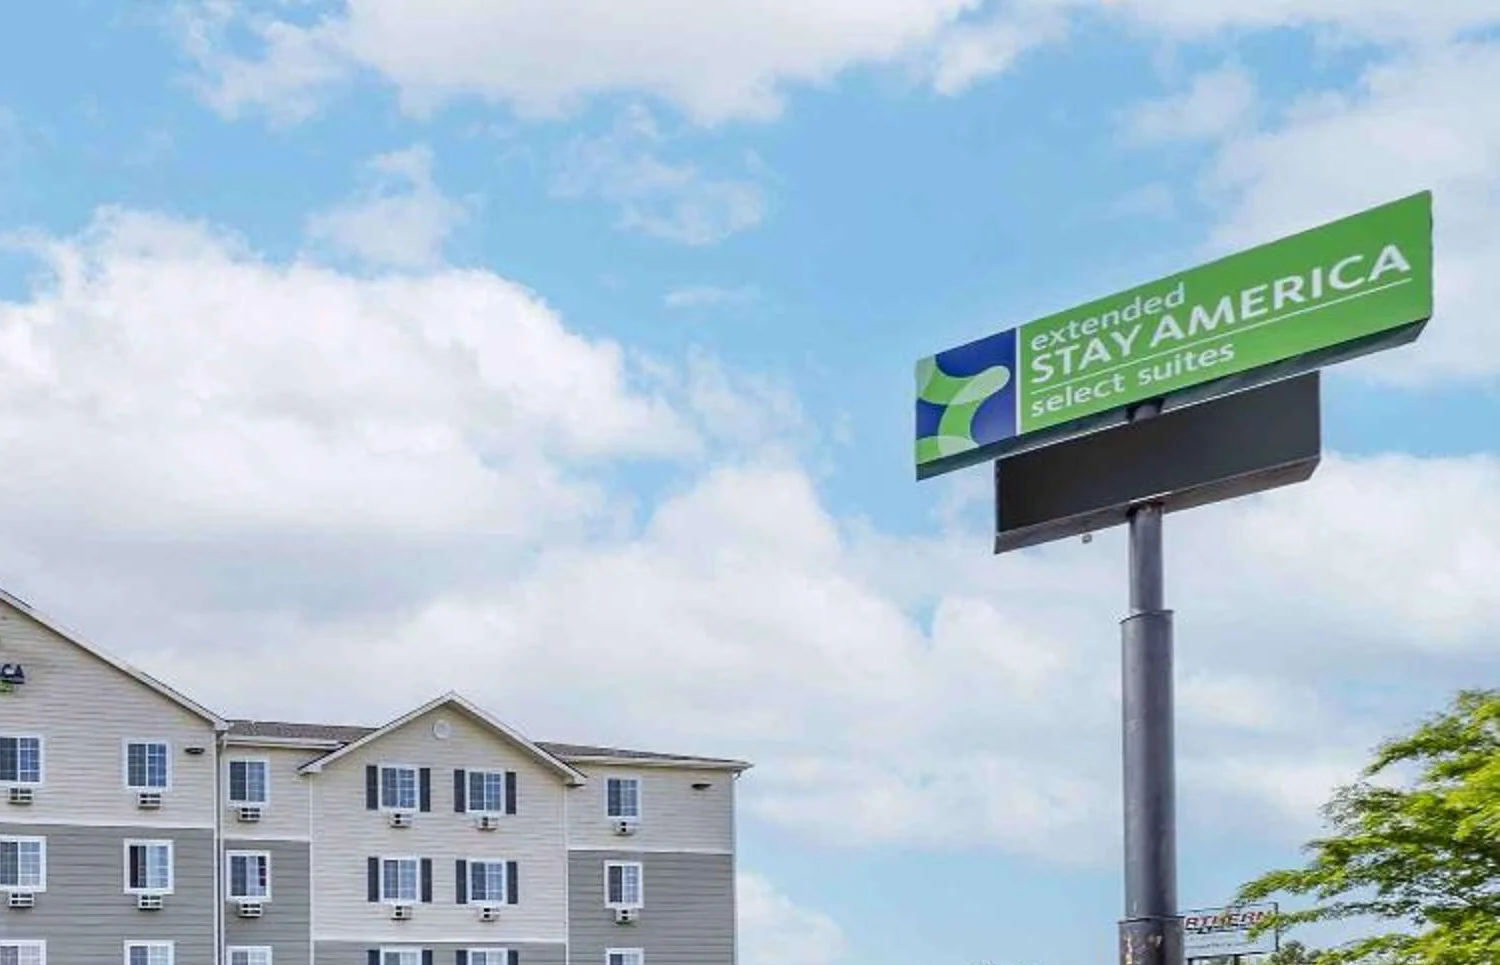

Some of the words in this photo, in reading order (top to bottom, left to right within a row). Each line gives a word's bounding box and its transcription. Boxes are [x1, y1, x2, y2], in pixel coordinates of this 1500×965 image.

[1031, 323, 1143, 384] STAY
[1150, 243, 1412, 348] AMERICA
[1031, 281, 1186, 351] extended
[1031, 373, 1126, 418] select
[1138, 342, 1235, 386] suites
